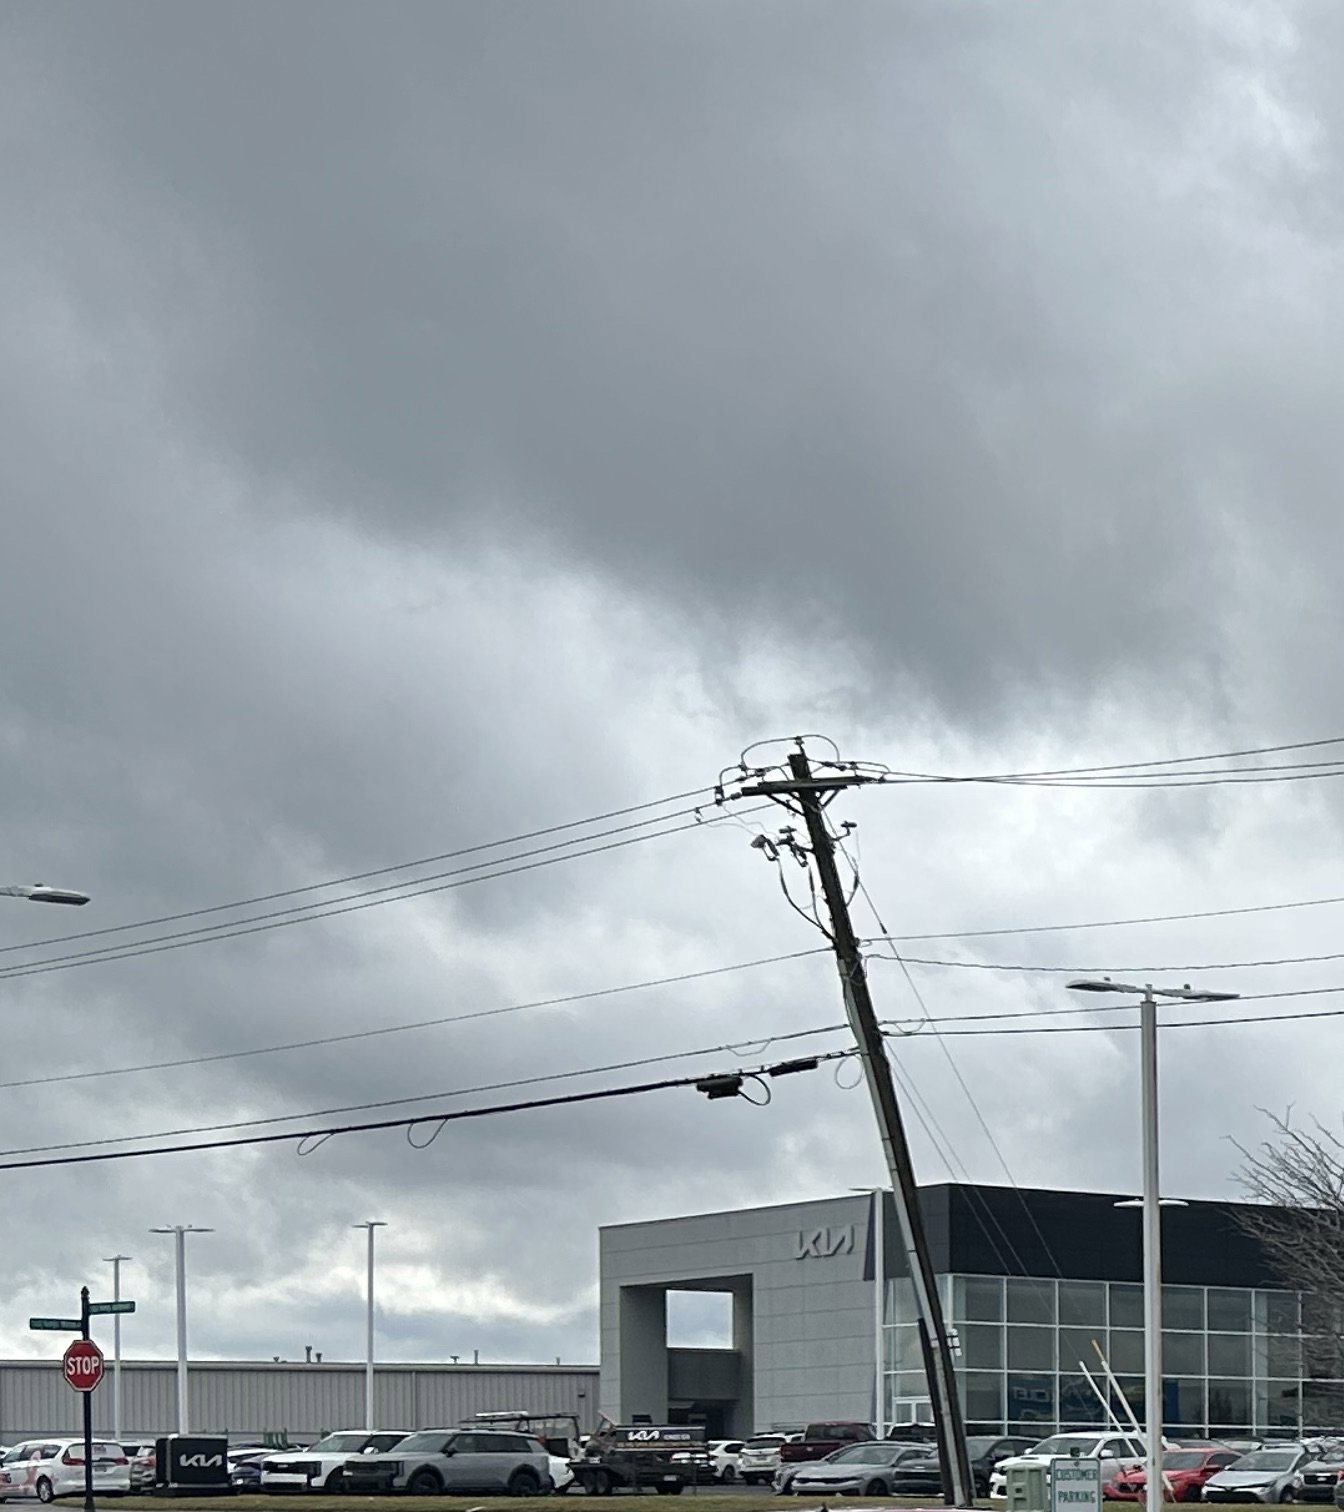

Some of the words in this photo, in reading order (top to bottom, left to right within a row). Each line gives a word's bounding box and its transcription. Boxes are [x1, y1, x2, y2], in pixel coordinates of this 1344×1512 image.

[796, 1225, 855, 1260] KIA
[67, 1356, 100, 1375] STOP
[627, 1431, 660, 1441] KIA
[180, 1453, 222, 1467] KIA
[1054, 1469, 1097, 1481] CUSTOMER
[1058, 1490, 1096, 1503] PARKING
